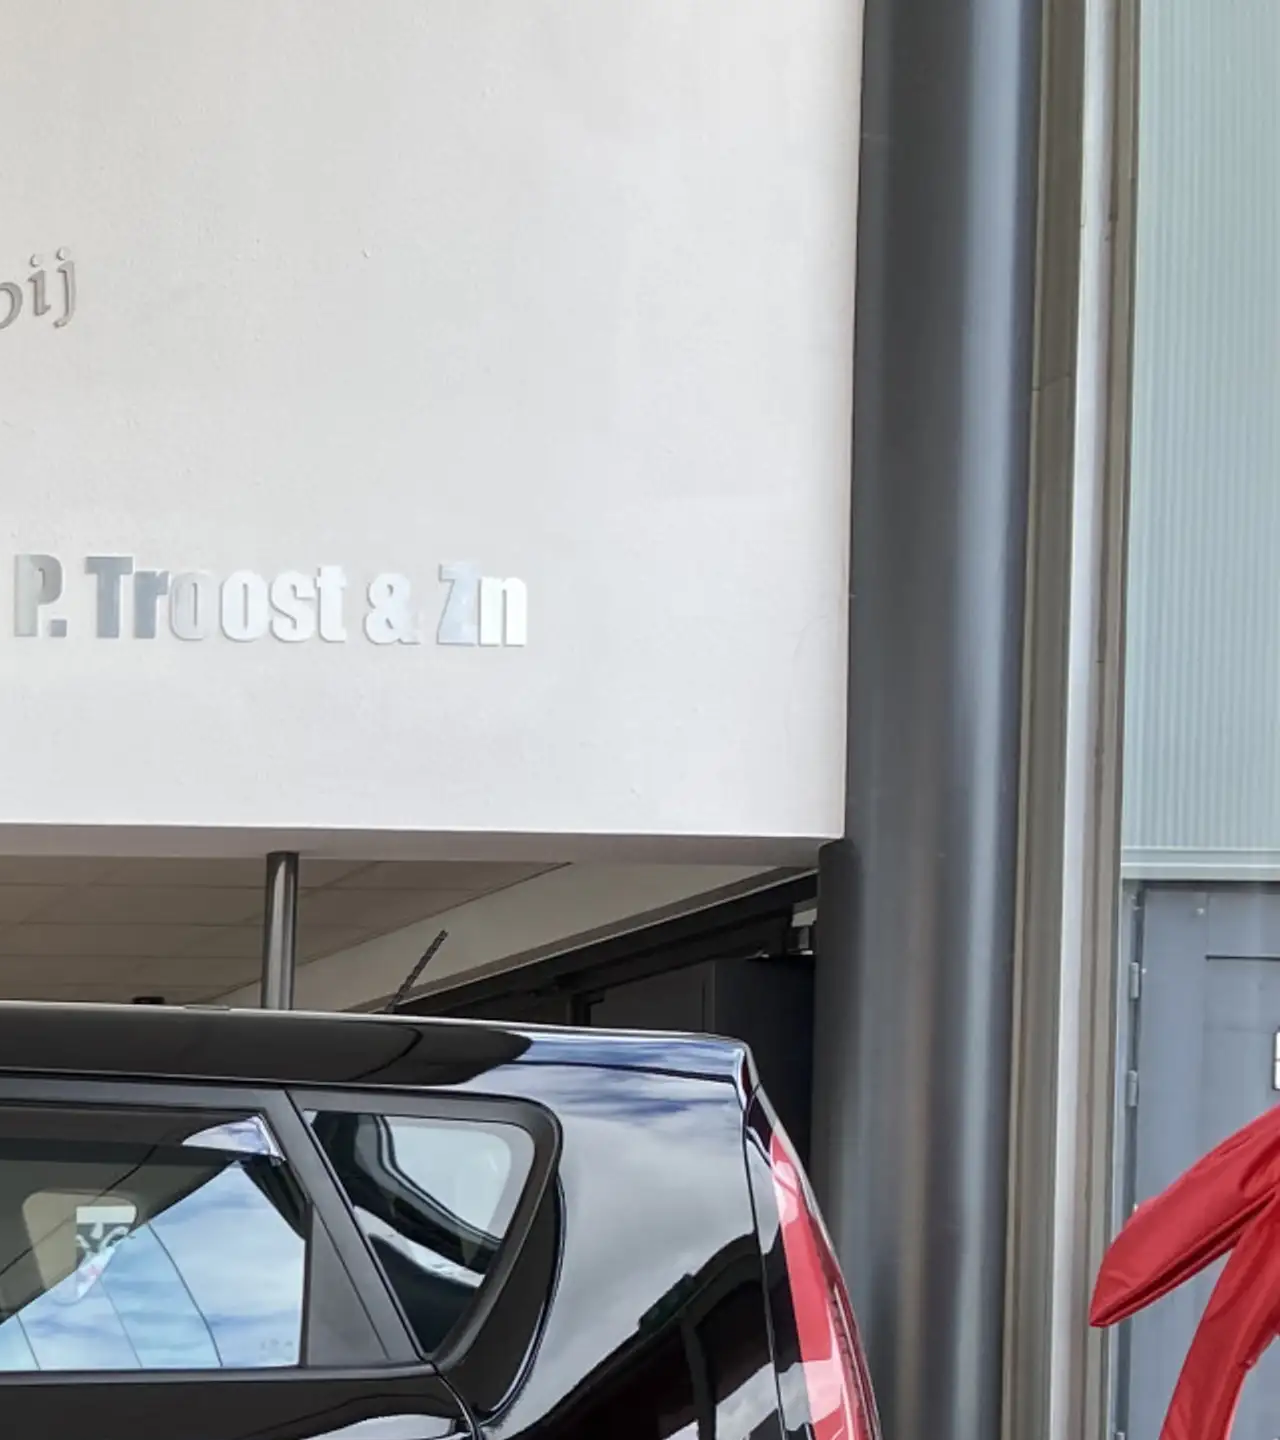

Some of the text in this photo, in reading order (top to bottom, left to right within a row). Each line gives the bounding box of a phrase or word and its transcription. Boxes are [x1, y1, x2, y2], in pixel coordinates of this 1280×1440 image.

[12, 553, 66, 638] P.
[84, 555, 348, 645] Troost
[363, 580, 420, 645] &
[437, 561, 529, 648] Zn
